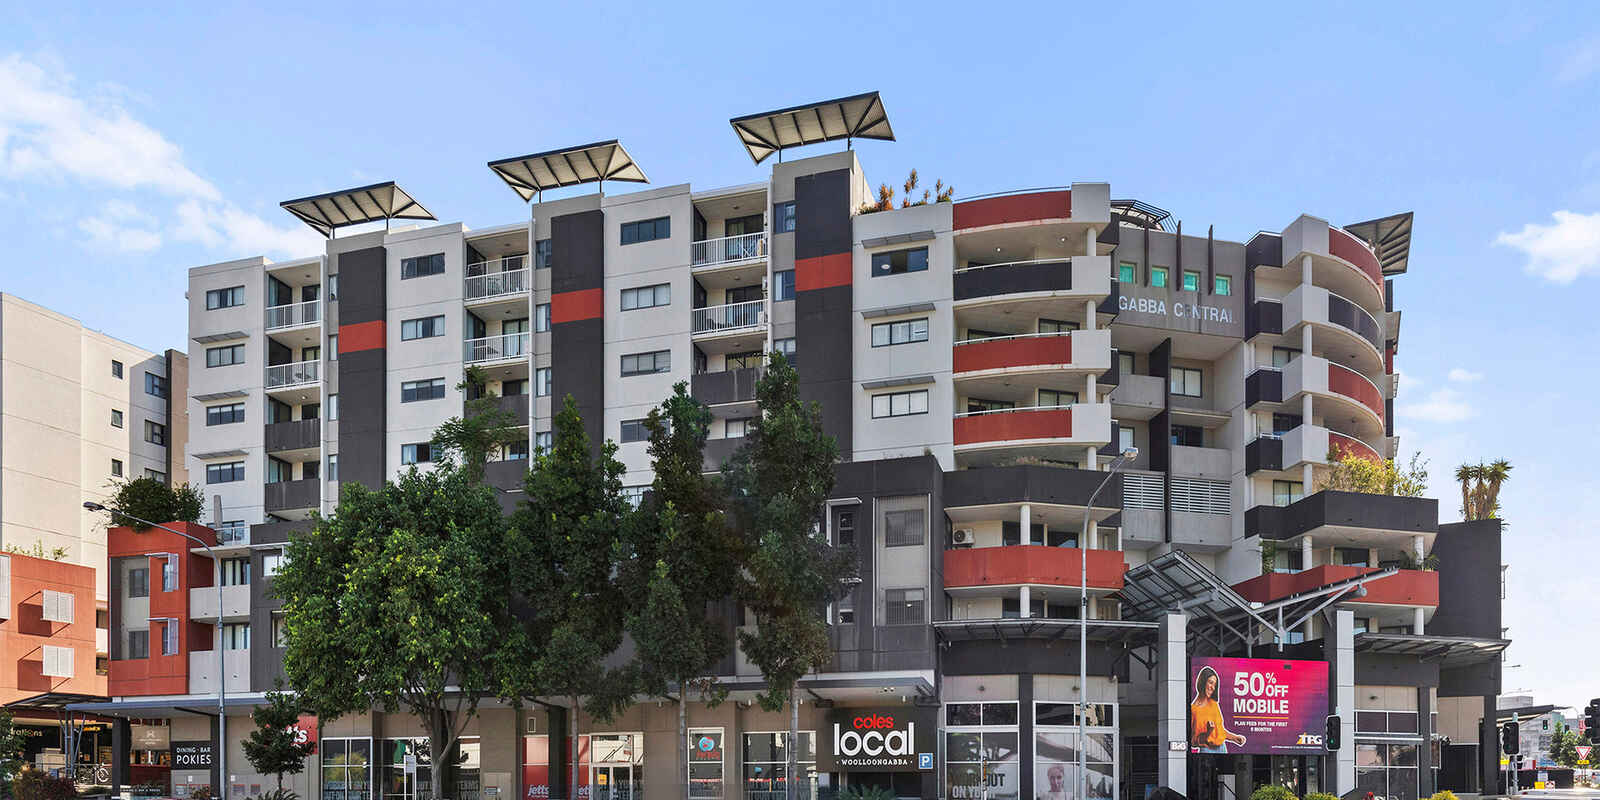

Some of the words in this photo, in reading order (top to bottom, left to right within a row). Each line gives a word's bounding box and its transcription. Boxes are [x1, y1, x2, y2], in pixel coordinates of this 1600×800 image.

[1118, 295, 1167, 315] GABBA
[1265, 684, 1289, 697] OFF
[1233, 698, 1289, 714] MOBILE
[853, 713, 894, 729] coles
[833, 721, 915, 757] local
[176, 754, 211, 765] POKIES
[527, 784, 550, 797] jetts
